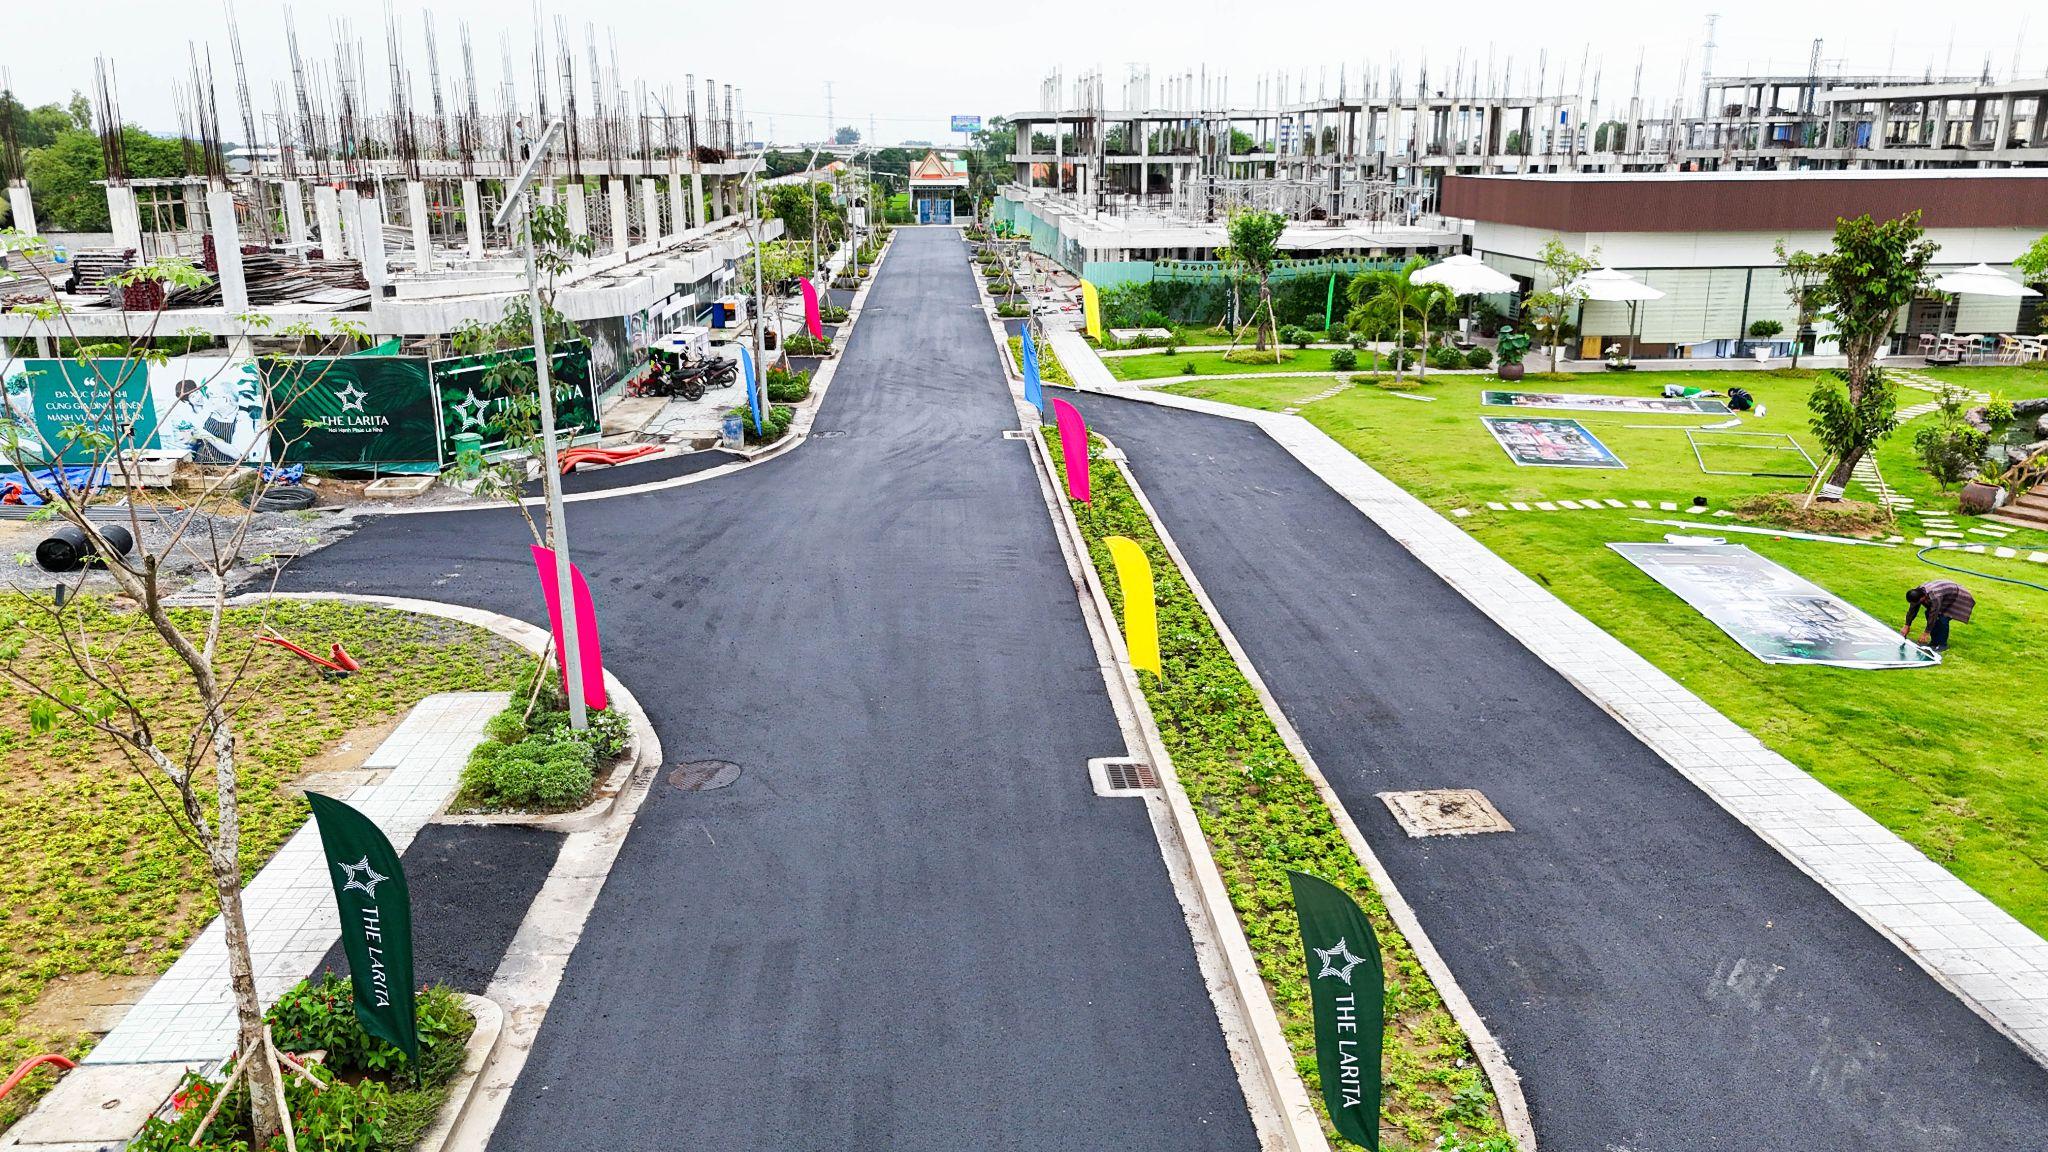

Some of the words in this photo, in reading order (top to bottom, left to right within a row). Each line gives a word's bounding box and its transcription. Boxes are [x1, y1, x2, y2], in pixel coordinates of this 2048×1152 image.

[319, 415, 344, 426] THE
[347, 415, 389, 426] LARITA
[361, 905, 382, 943] THE
[368, 947, 391, 1008] LARITA
[1335, 992, 1357, 1034] THE
[1338, 1041, 1361, 1109] LARITA
